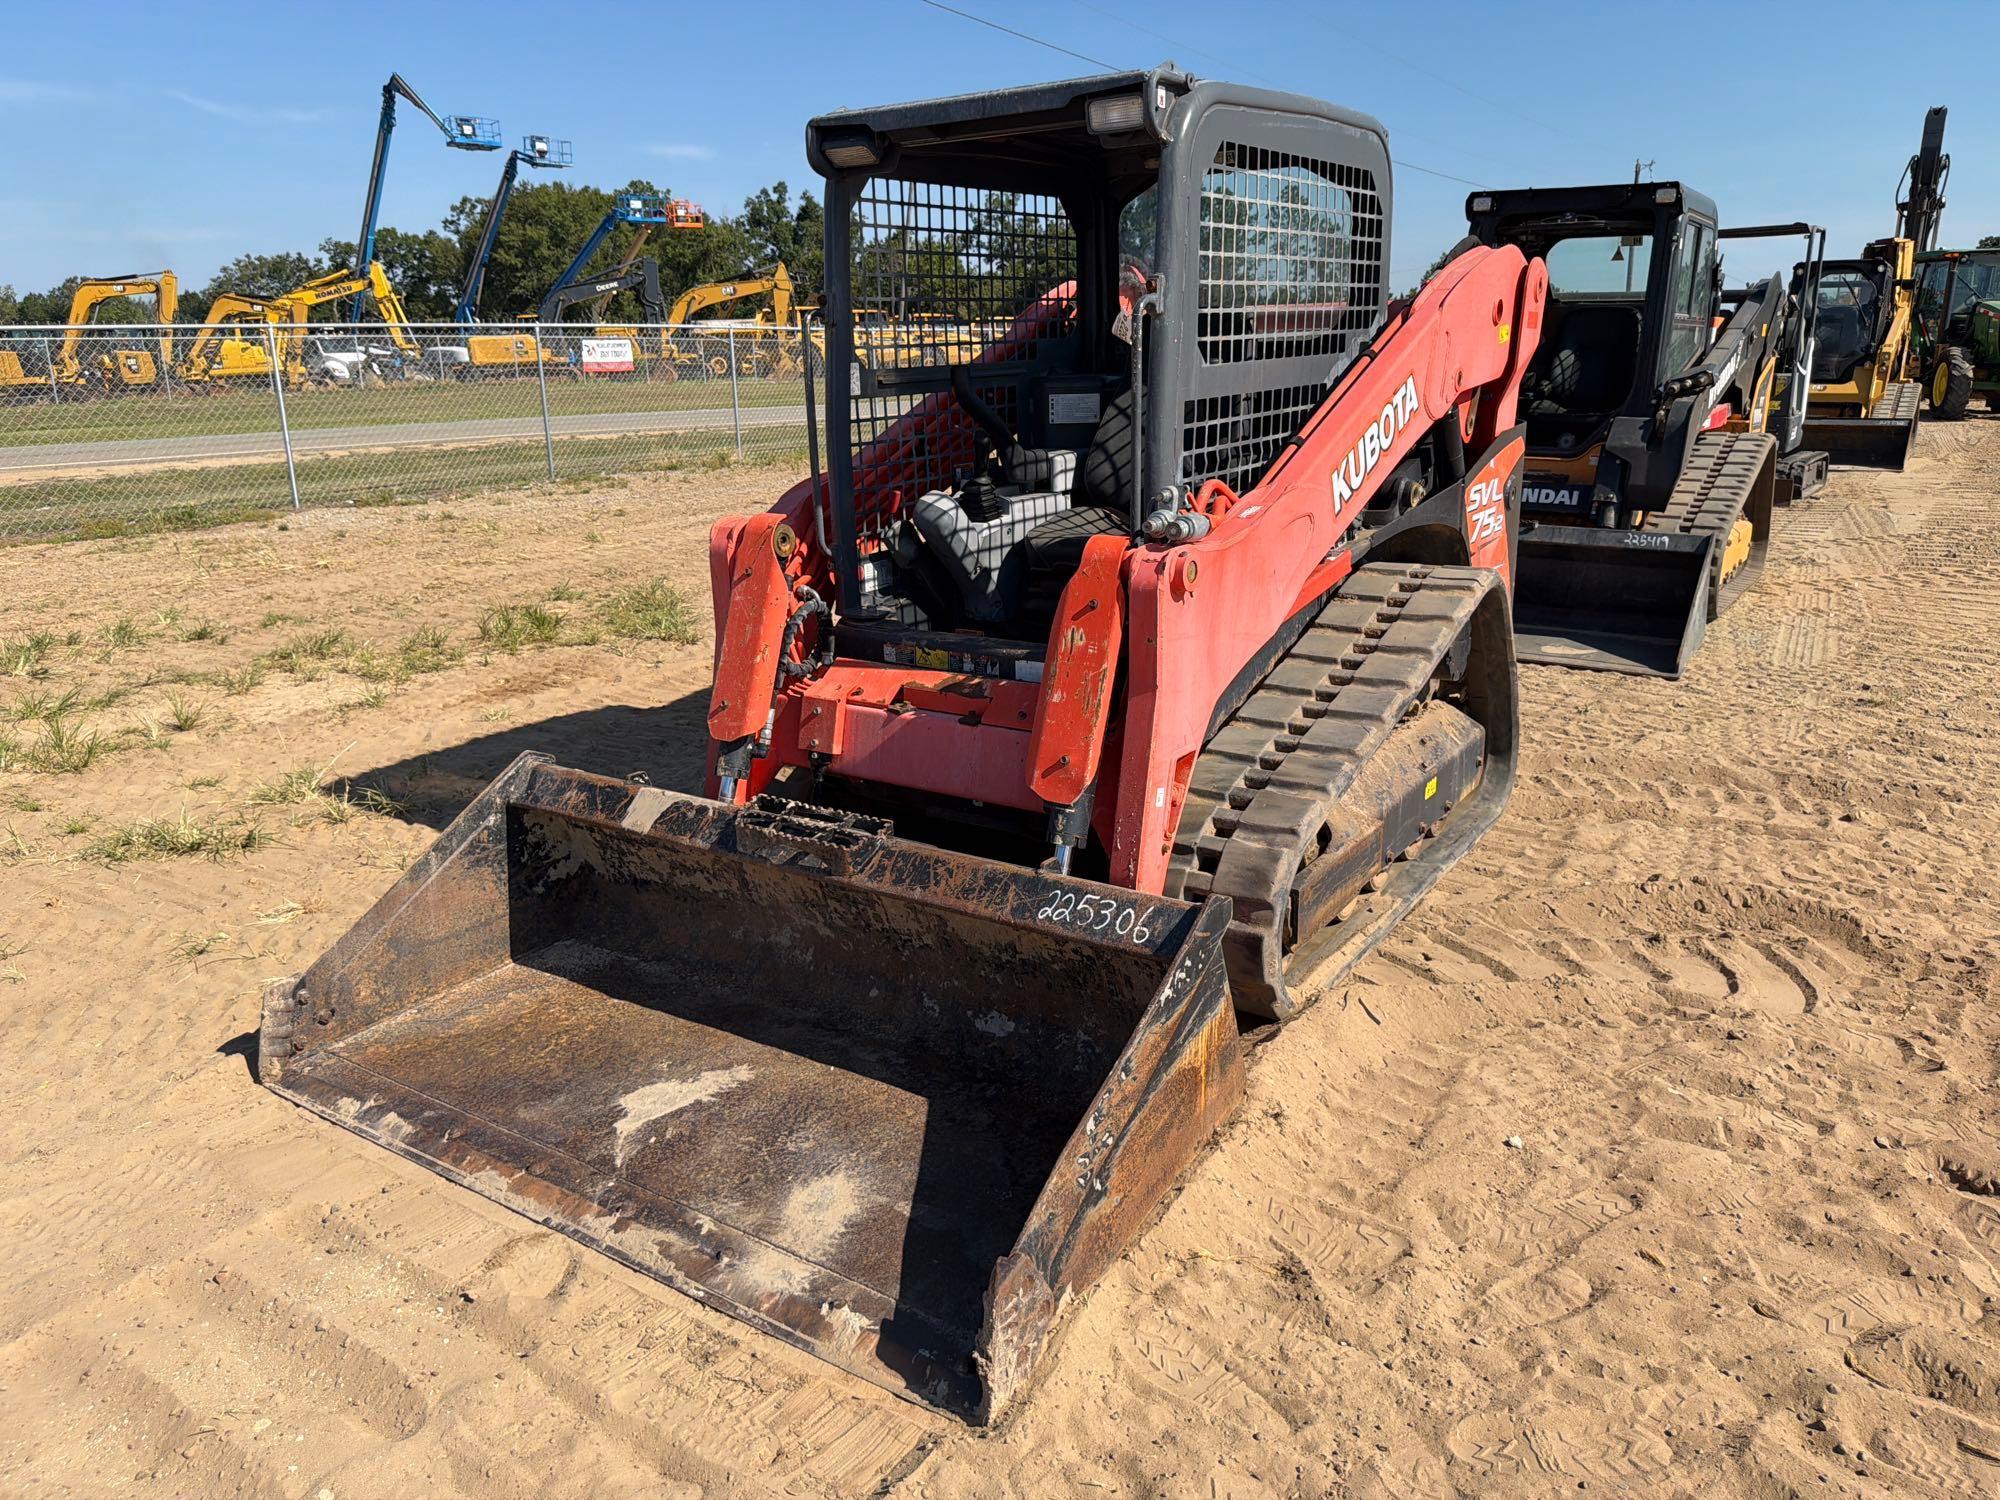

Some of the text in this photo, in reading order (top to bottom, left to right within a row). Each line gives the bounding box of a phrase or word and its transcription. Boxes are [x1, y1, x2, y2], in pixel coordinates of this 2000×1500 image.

[315, 285, 353, 299] KOMATSU
[596, 281, 619, 291] DEERE
[722, 286, 734, 295] CAT
[1331, 373, 1419, 515] KUBOTA
[1467, 478, 1503, 513] SVL
[1521, 487, 1580, 506] NDAI
[1625, 532, 1669, 547] 225419
[1037, 889, 1155, 944] 225306
